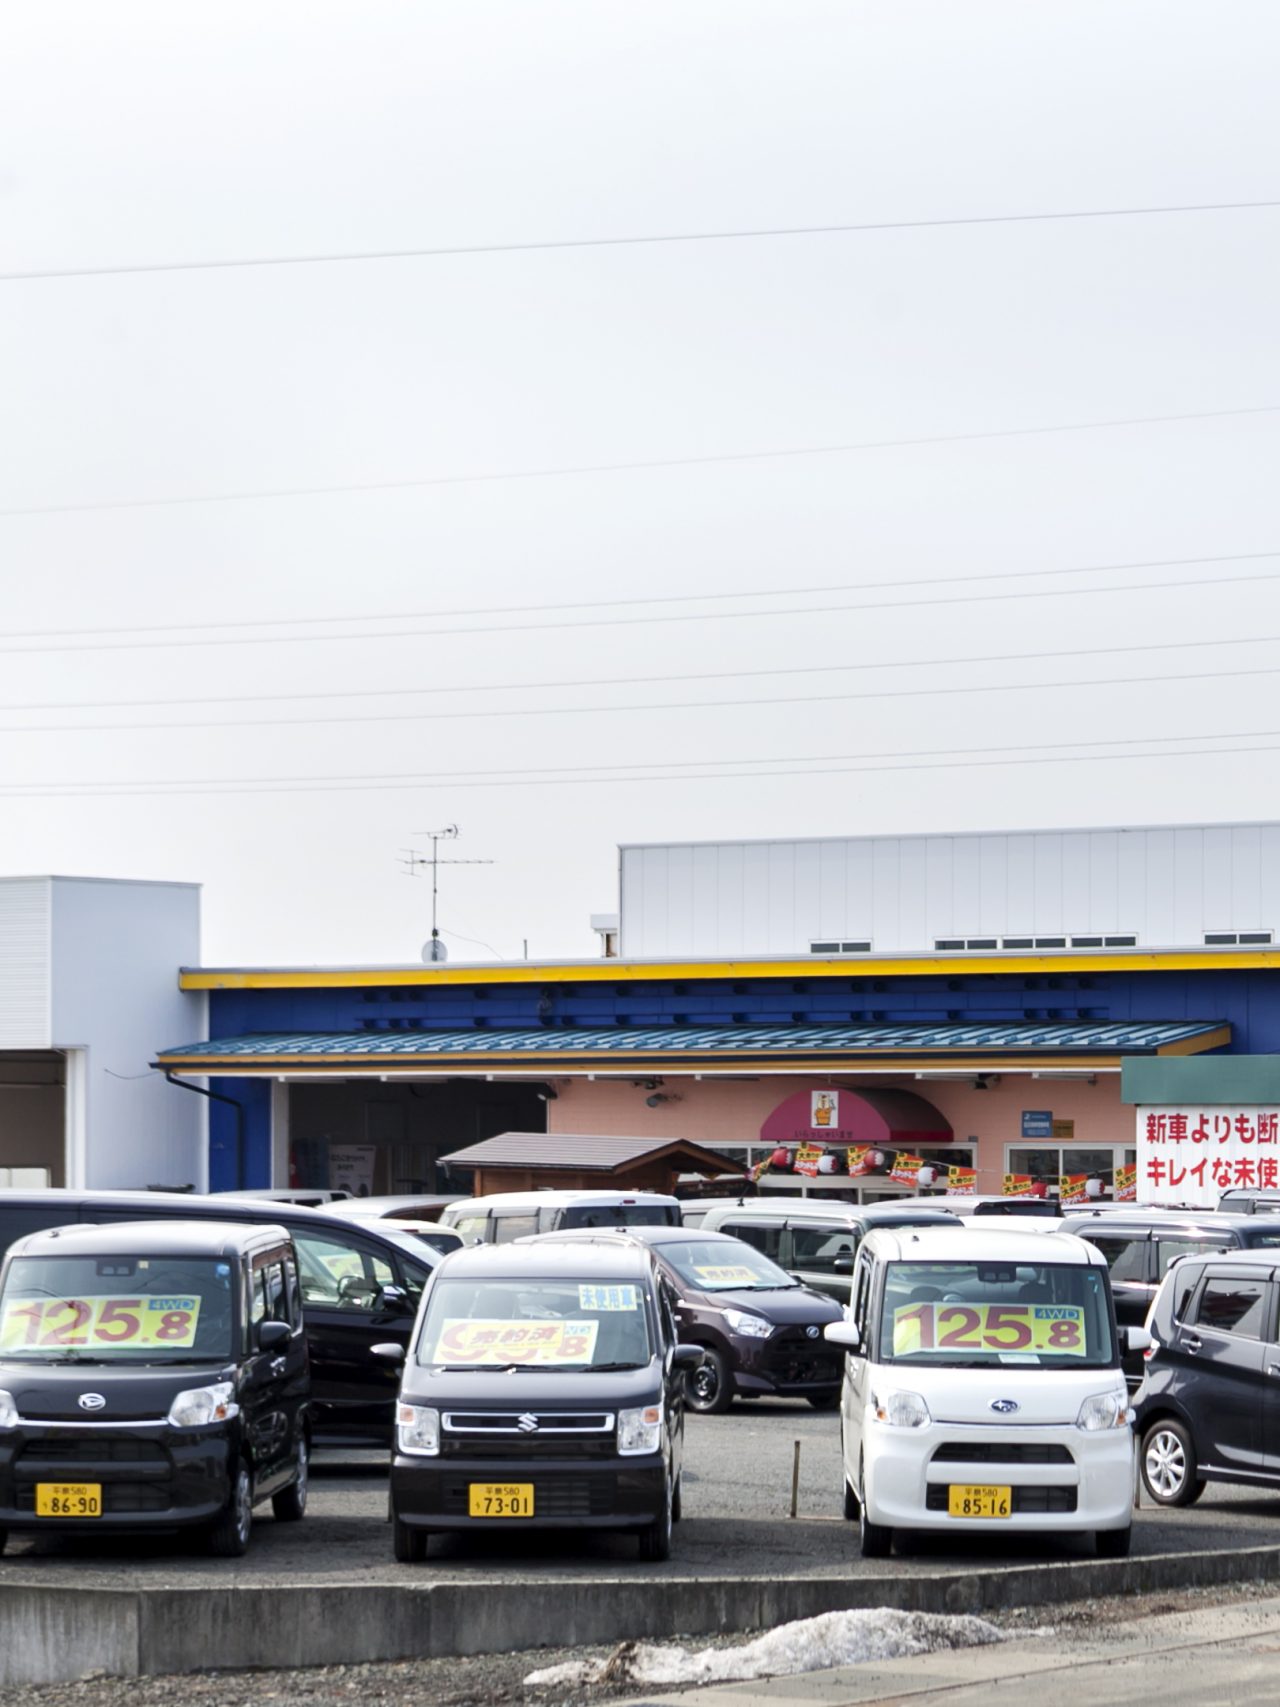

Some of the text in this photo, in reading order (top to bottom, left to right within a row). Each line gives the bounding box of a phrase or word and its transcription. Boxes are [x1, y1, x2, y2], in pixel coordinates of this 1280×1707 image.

[151, 1299, 193, 1311] 4WD
[1038, 1308, 1079, 1319] 4WD
[9, 1299, 193, 1346] 125.8
[896, 1304, 1081, 1349] 125.8
[471, 1326, 560, 1344] 売約済
[52, 1497, 97, 1513] 86-90
[484, 1497, 528, 1514] 73-01
[963, 1498, 1007, 1515] 85-16
